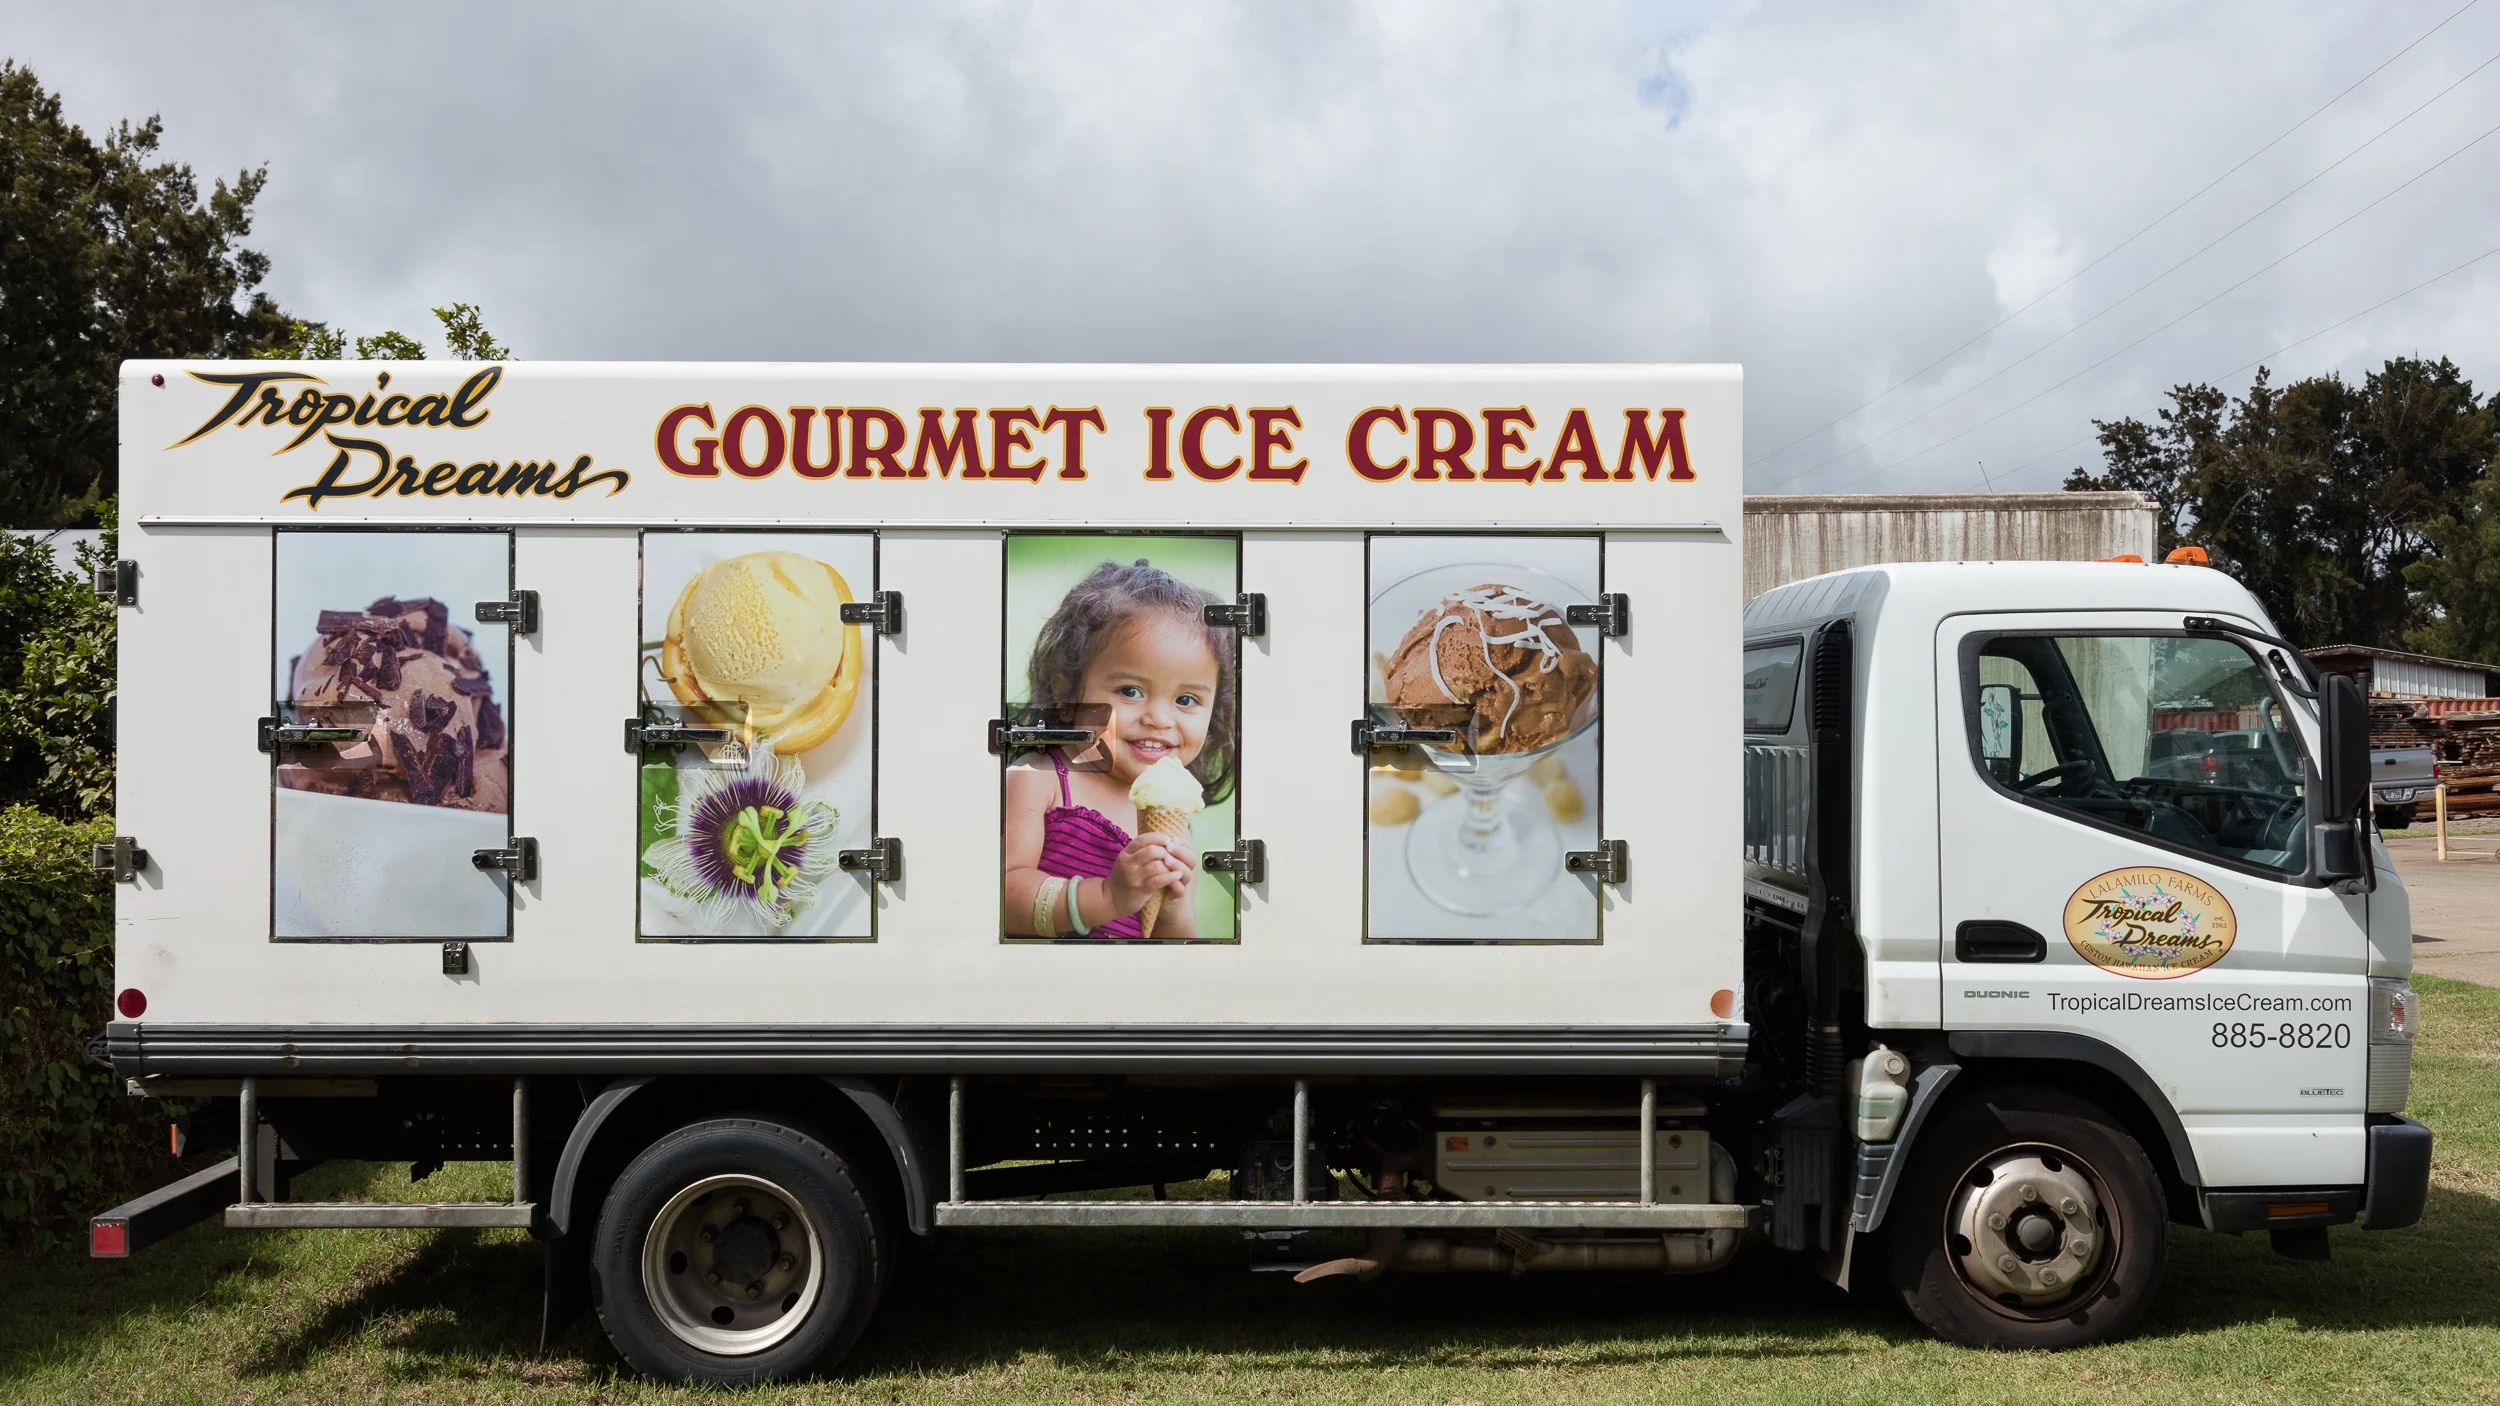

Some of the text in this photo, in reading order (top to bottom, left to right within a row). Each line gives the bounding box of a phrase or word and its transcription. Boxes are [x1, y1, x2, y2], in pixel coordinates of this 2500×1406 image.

[164, 365, 506, 456] Tropical
[654, 402, 1697, 485] GOURMET ICE CREAM
[280, 431, 631, 512] Dreams
[2089, 873, 2215, 907] LALAMILO FARMS
[2072, 898, 2183, 928] Tropical
[2111, 922, 2223, 949] Dreams
[2080, 940, 2213, 973] CUSTOM HAWAIIAN ICE CREAM
[1964, 990, 2030, 999] DUONIC
[2047, 992, 2352, 1015] TropicalDreamsIceCream.com
[2211, 1022, 2351, 1049] 885-8820
[2300, 1088, 2344, 1096] BLUETEC
